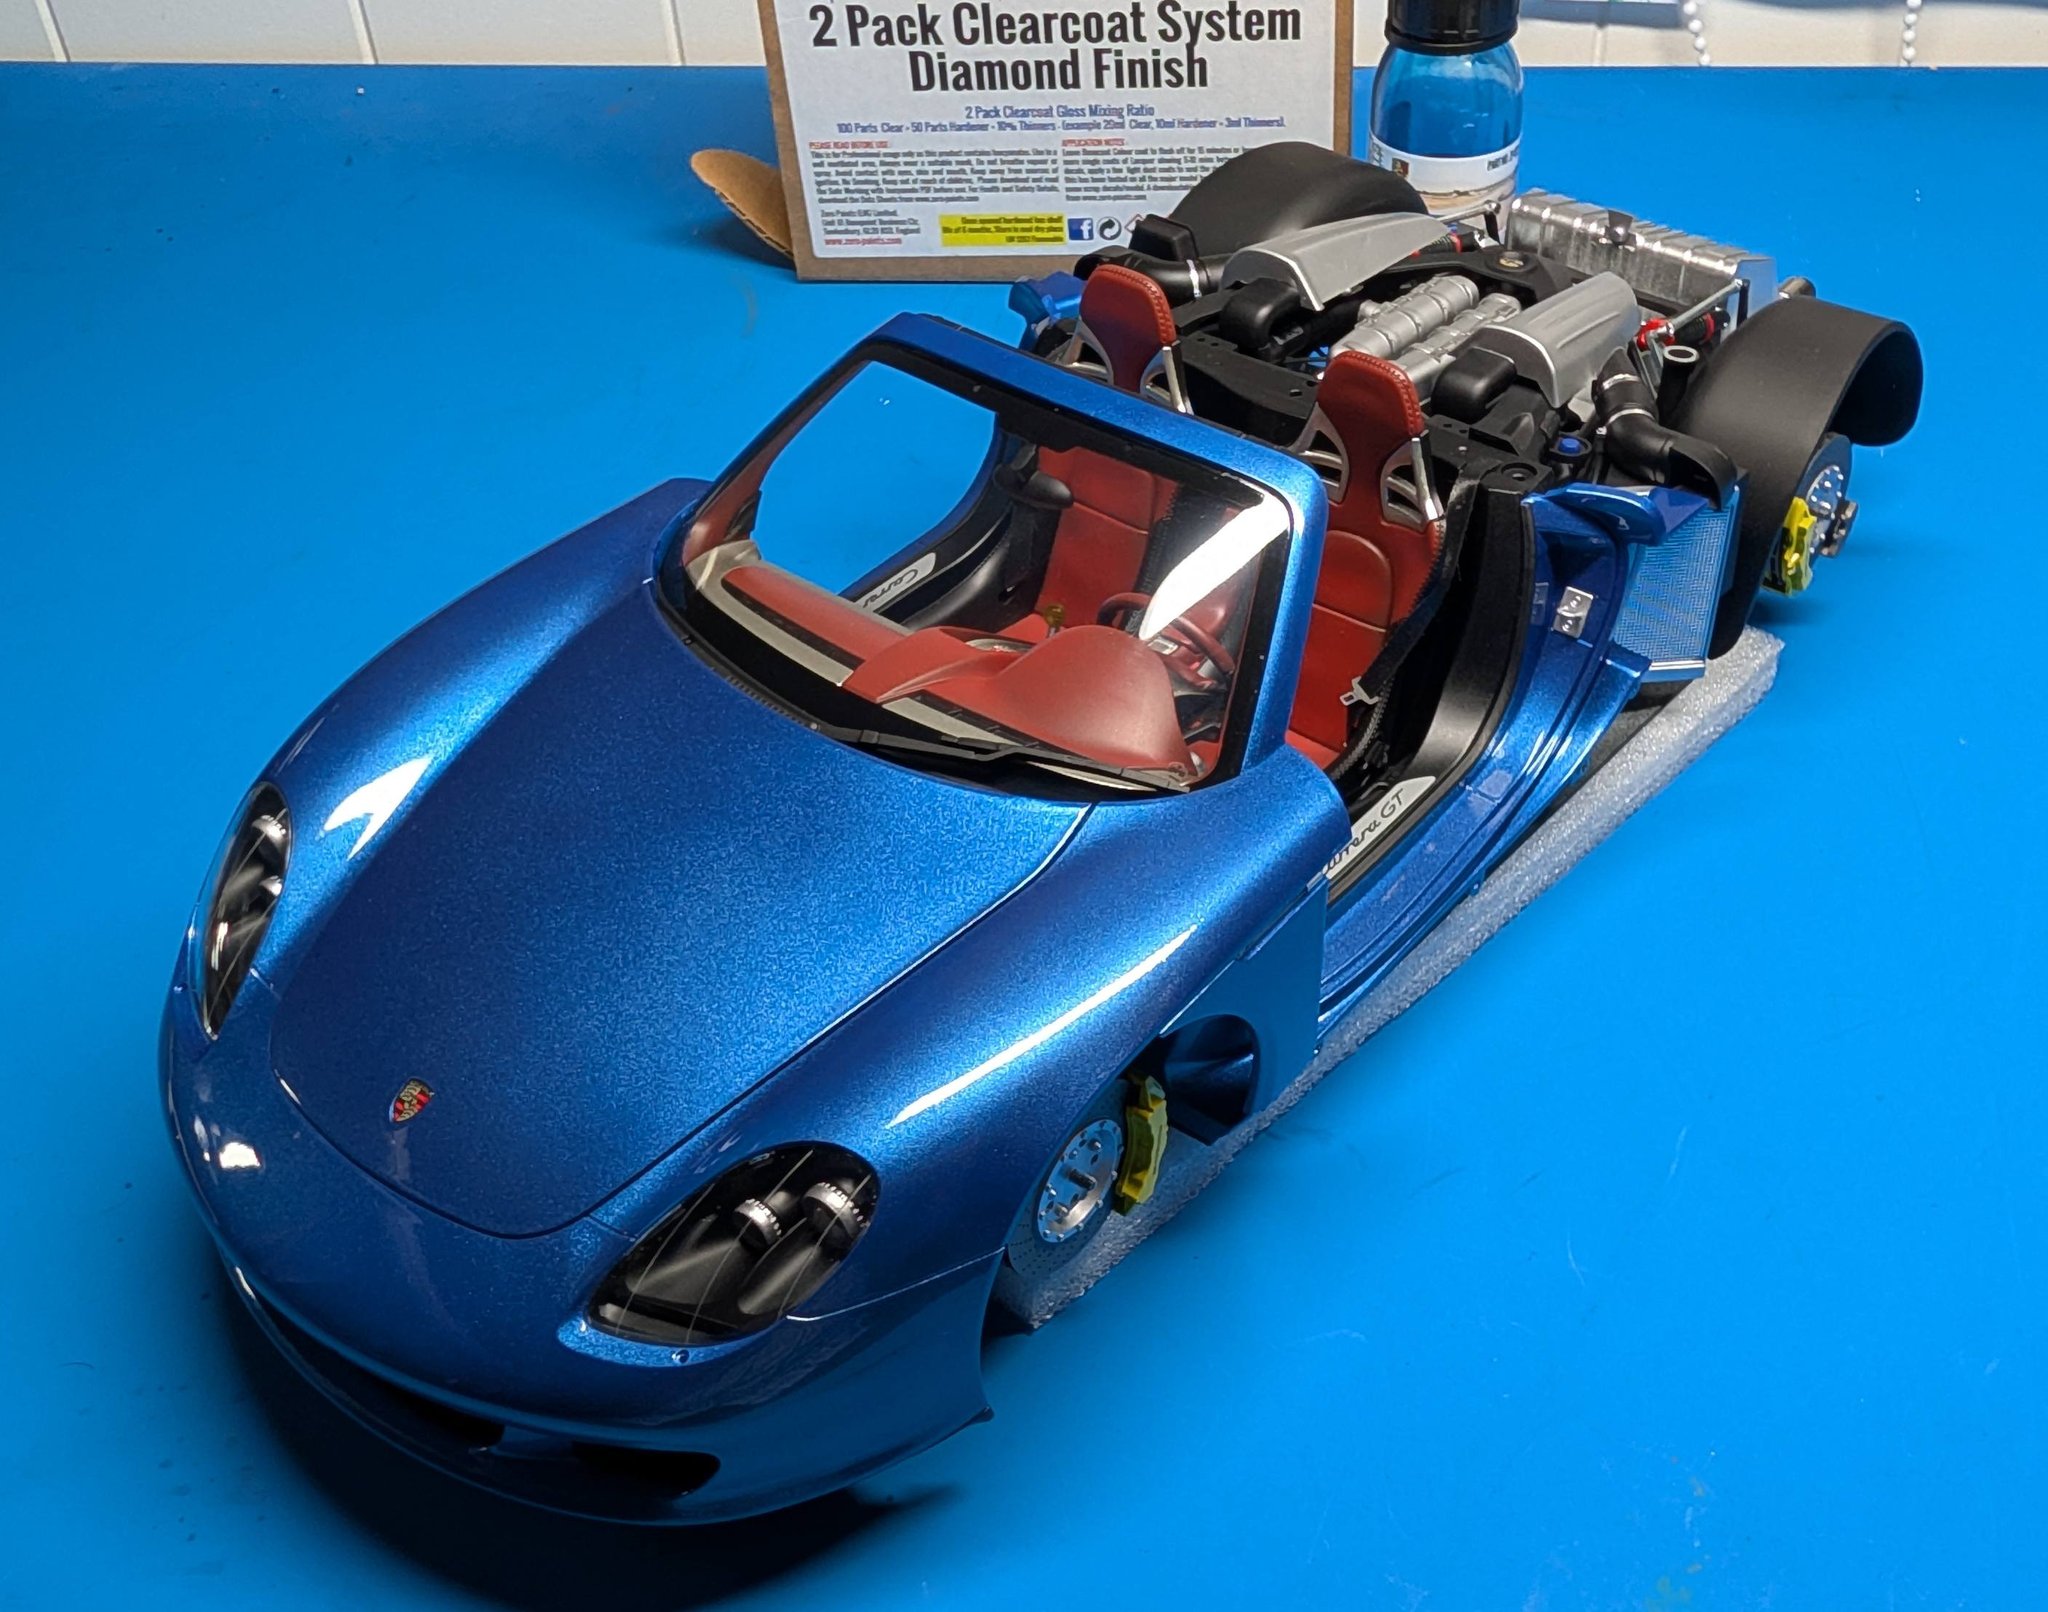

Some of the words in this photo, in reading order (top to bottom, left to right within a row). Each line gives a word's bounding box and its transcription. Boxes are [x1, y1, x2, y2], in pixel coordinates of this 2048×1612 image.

[810, 5, 836, 46] 2
[846, 4, 943, 46] Pack
[953, 3, 1146, 45] Clearcoat
[1158, 0, 1300, 48] System
[909, 49, 1080, 91] Diamond
[1094, 46, 1207, 88] Finish
[855, 123, 877, 133] Parts
[881, 123, 903, 132] Clear
[911, 122, 922, 132] 50
[925, 122, 947, 132] Parts
[949, 123, 989, 131] Hardener
[965, 106, 974, 119] 2
[976, 106, 1000, 118] Pack
[1003, 106, 1053, 118] Clearcoat
[1057, 105, 1085, 117] Gloss
[1089, 105, 1124, 118] Mixing
[1127, 104, 1154, 116] Ratio
[862, 568, 918, 608] Carrer
[1322, 819, 1382, 874] arrera
[1381, 788, 1404, 818] GT
